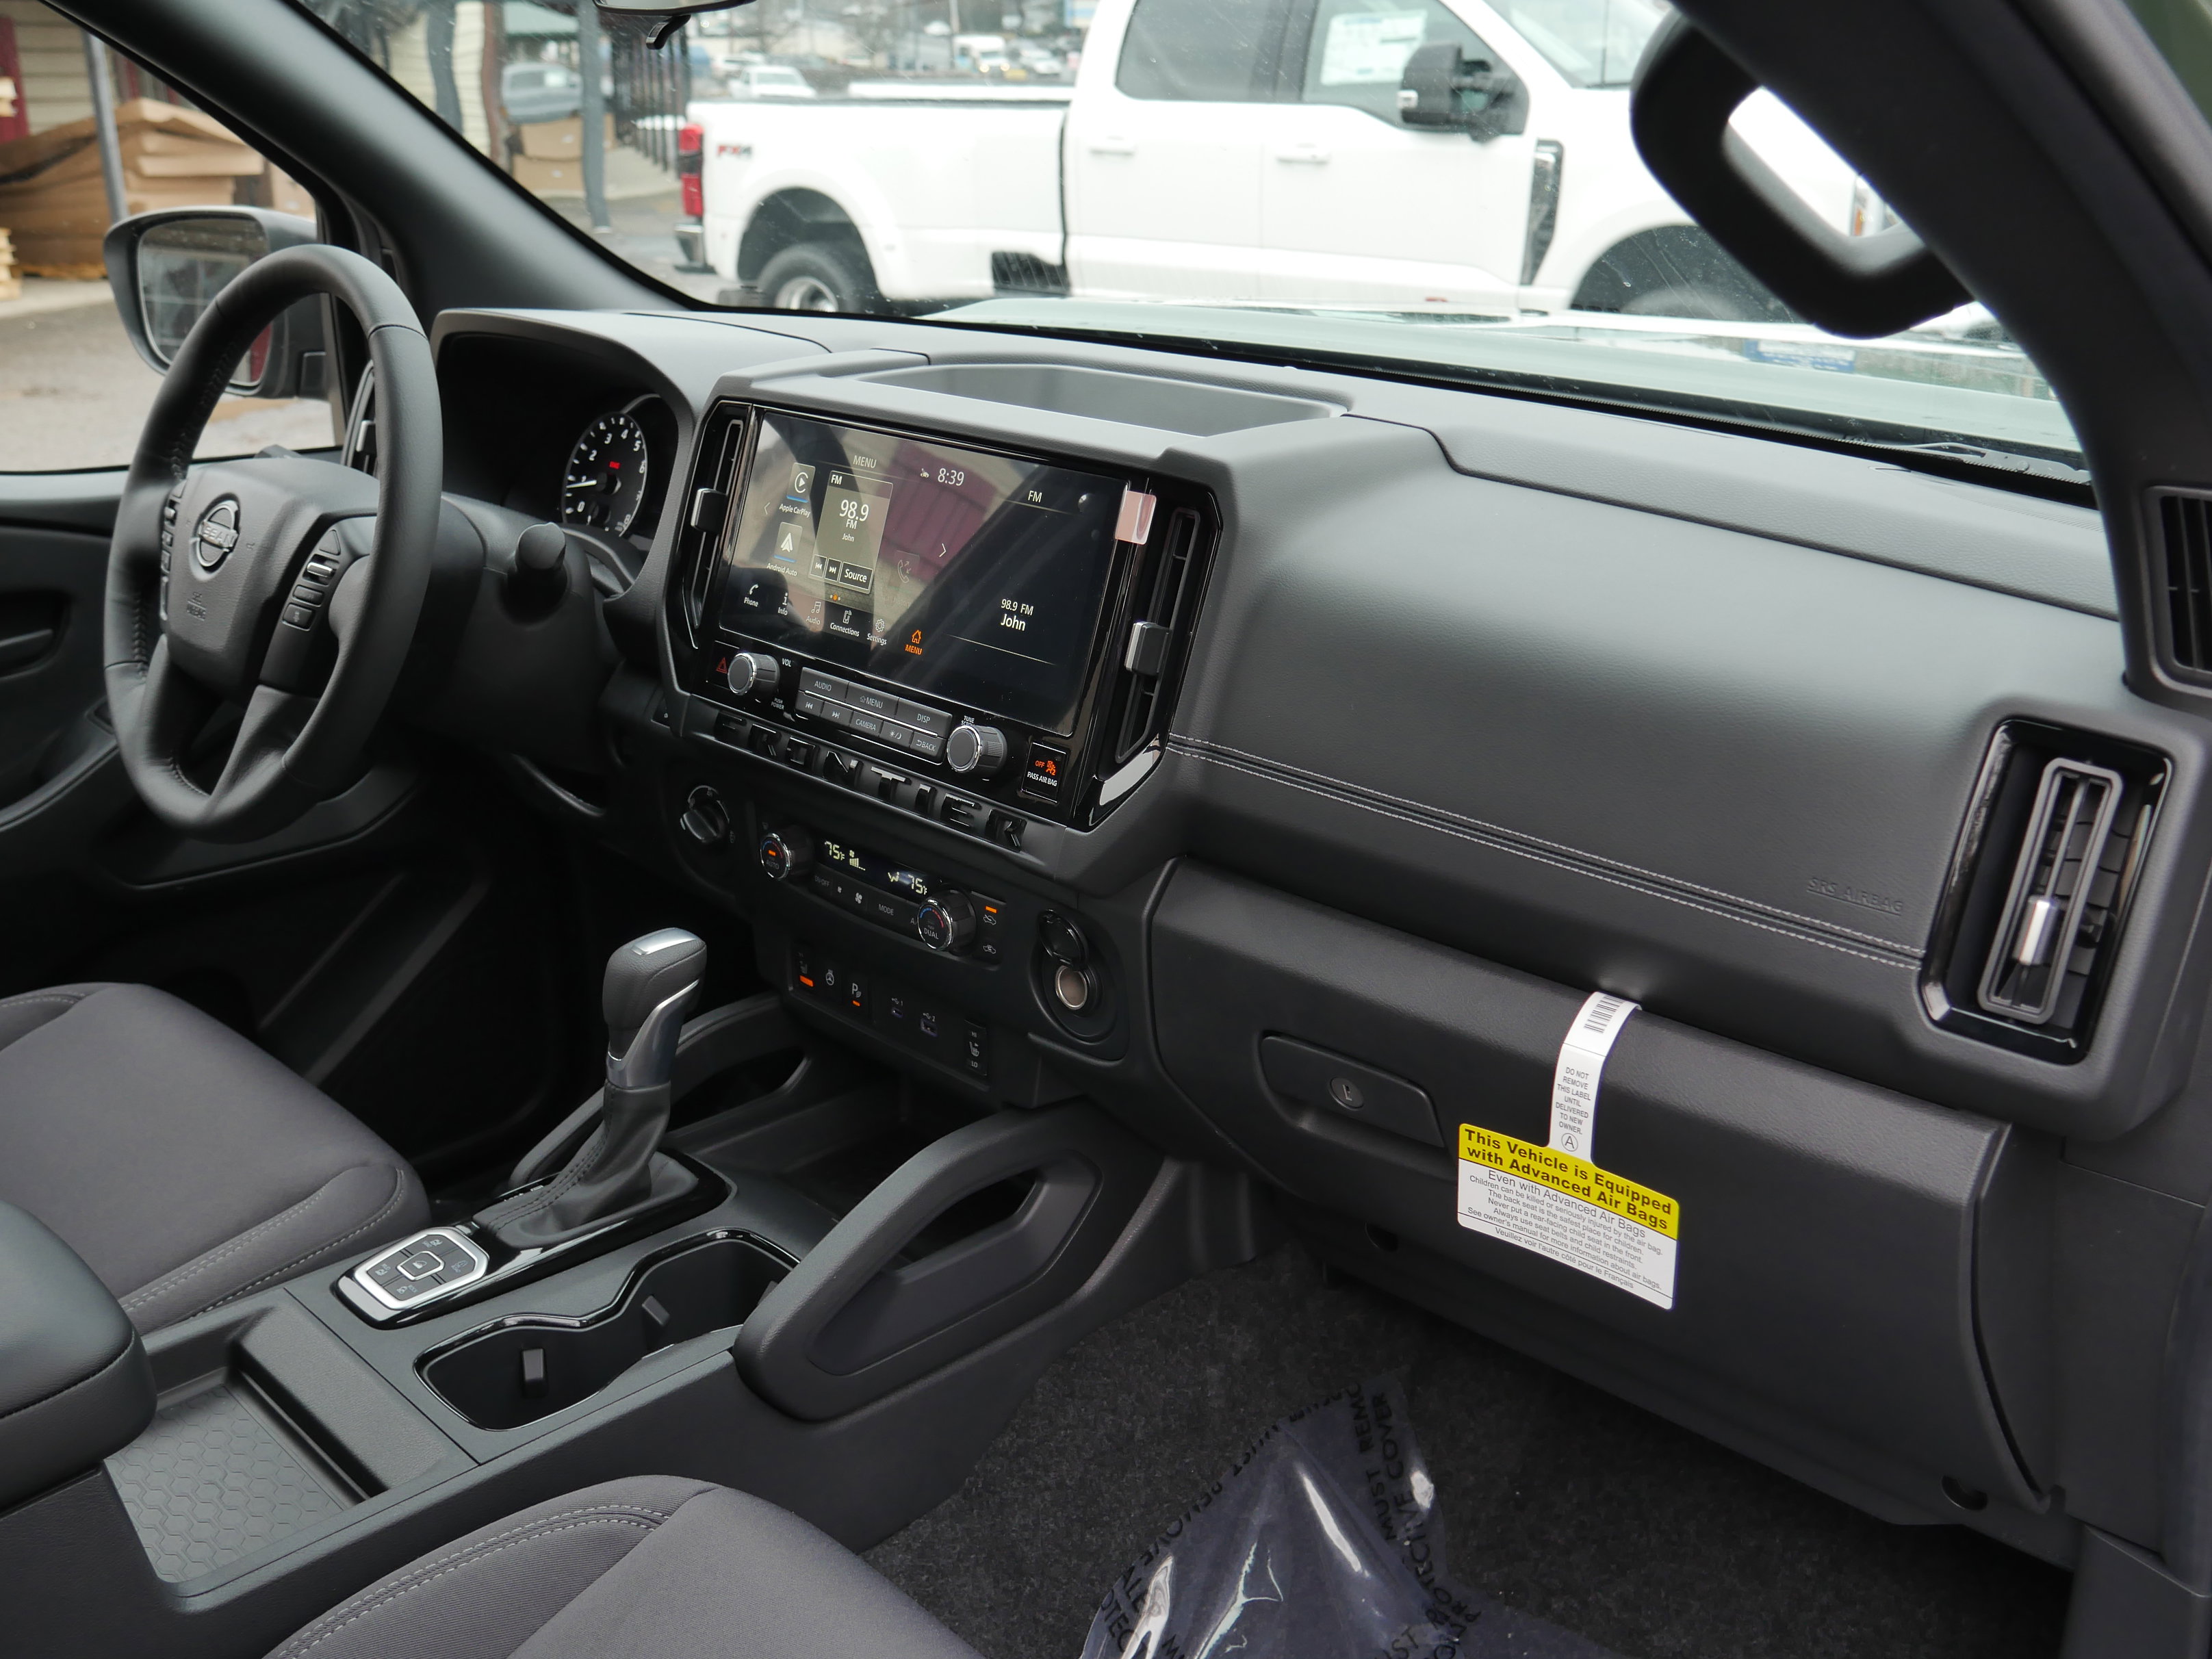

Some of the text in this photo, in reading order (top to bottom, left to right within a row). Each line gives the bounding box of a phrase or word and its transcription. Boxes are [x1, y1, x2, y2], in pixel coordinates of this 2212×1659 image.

[605, 433, 612, 443] 3
[621, 429, 628, 439] 4
[634, 441, 641, 451] 5
[589, 450, 597, 461] 2
[853, 455, 877, 469] MENU
[831, 474, 843, 485] FM
[938, 467, 964, 487] 8:39
[1027, 489, 1042, 503] FM
[577, 501, 585, 512] 0
[780, 503, 811, 518] Apple CarPlay
[839, 499, 869, 522] 98.9
[846, 519, 857, 530] FM
[842, 533, 855, 542] John
[767, 563, 797, 576] Android Auto
[844, 568, 867, 583] Source
[744, 597, 759, 608] Phone
[1001, 599, 1034, 616] 98.9 FM
[777, 606, 788, 616] Info
[806, 615, 821, 626] Audio
[1000, 613, 1027, 632] John
[830, 622, 860, 637] Connections
[866, 632, 887, 645] Settings
[905, 644, 923, 656] MENU
[782, 658, 792, 667] VOL
[814, 680, 832, 692] AUDIO
[771, 702, 784, 710] POWER
[866, 697, 883, 709] MENU
[916, 713, 930, 723] DISP
[964, 715, 975, 723] TUNE
[856, 719, 876, 731] CAMERA
[922, 741, 936, 752] BACK
[1027, 771, 1057, 786] PASS AIR BAG
[1807, 877, 1903, 912] SRS AIRBAG
[878, 903, 894, 916] MODE
[923, 927, 939, 940] DUAL
[1566, 1067, 1589, 1079] DO NOT
[1563, 1077, 1589, 1090] REMOVE
[1557, 1084, 1591, 1101] THIS LABEL
[1565, 1096, 1582, 1107] UNTIL
[1556, 1102, 1589, 1118] DELIVERED
[1560, 1112, 1583, 1126] TO NEW
[1558, 1121, 1582, 1135] OWNER.
[1565, 1135, 1575, 1148] A
[1465, 1128, 1671, 1216] This Vehicle is Equipped
[1467, 1146, 1668, 1230] with Advanced Air Bags
[1489, 1170, 1647, 1240] Even with Advanced Air Bags
[1469, 1175, 1500, 1191] Children
[1500, 1186, 1514, 1195] can
[1515, 1189, 1525, 1199] be
[1526, 1193, 1545, 1206] killed
[1555, 1205, 1586, 1223] seriously
[1588, 1217, 1612, 1233] injured
[1613, 1227, 1623, 1238] by
[1623, 1232, 1636, 1242] the
[1636, 1239, 1647, 1247] air
[1647, 1242, 1663, 1256] bag.
[1488, 1188, 1644, 1256] The back seat is the safest place for children.
[1488, 1196, 1510, 1210] Never
[1510, 1206, 1522, 1215] put
[1530, 1213, 1567, 1233] rear-facing
[1569, 1228, 1586, 1239] child
[1586, 1235, 1603, 1246] seat
[1604, 1241, 1610, 1250] in
[1612, 1244, 1623, 1255] the
[1625, 1250, 1643, 1264] front.
[1493, 1207, 1637, 1270] Always use seat belts and child restraints.
[1467, 1207, 1662, 1291] See owner's manual for more information about air bags.
[1495, 1226, 1634, 1289] Veuillez voir l'autre côté pour le Français
[1372, 1391, 1404, 1480] COVER
[1366, 1469, 1397, 1541] MUST
